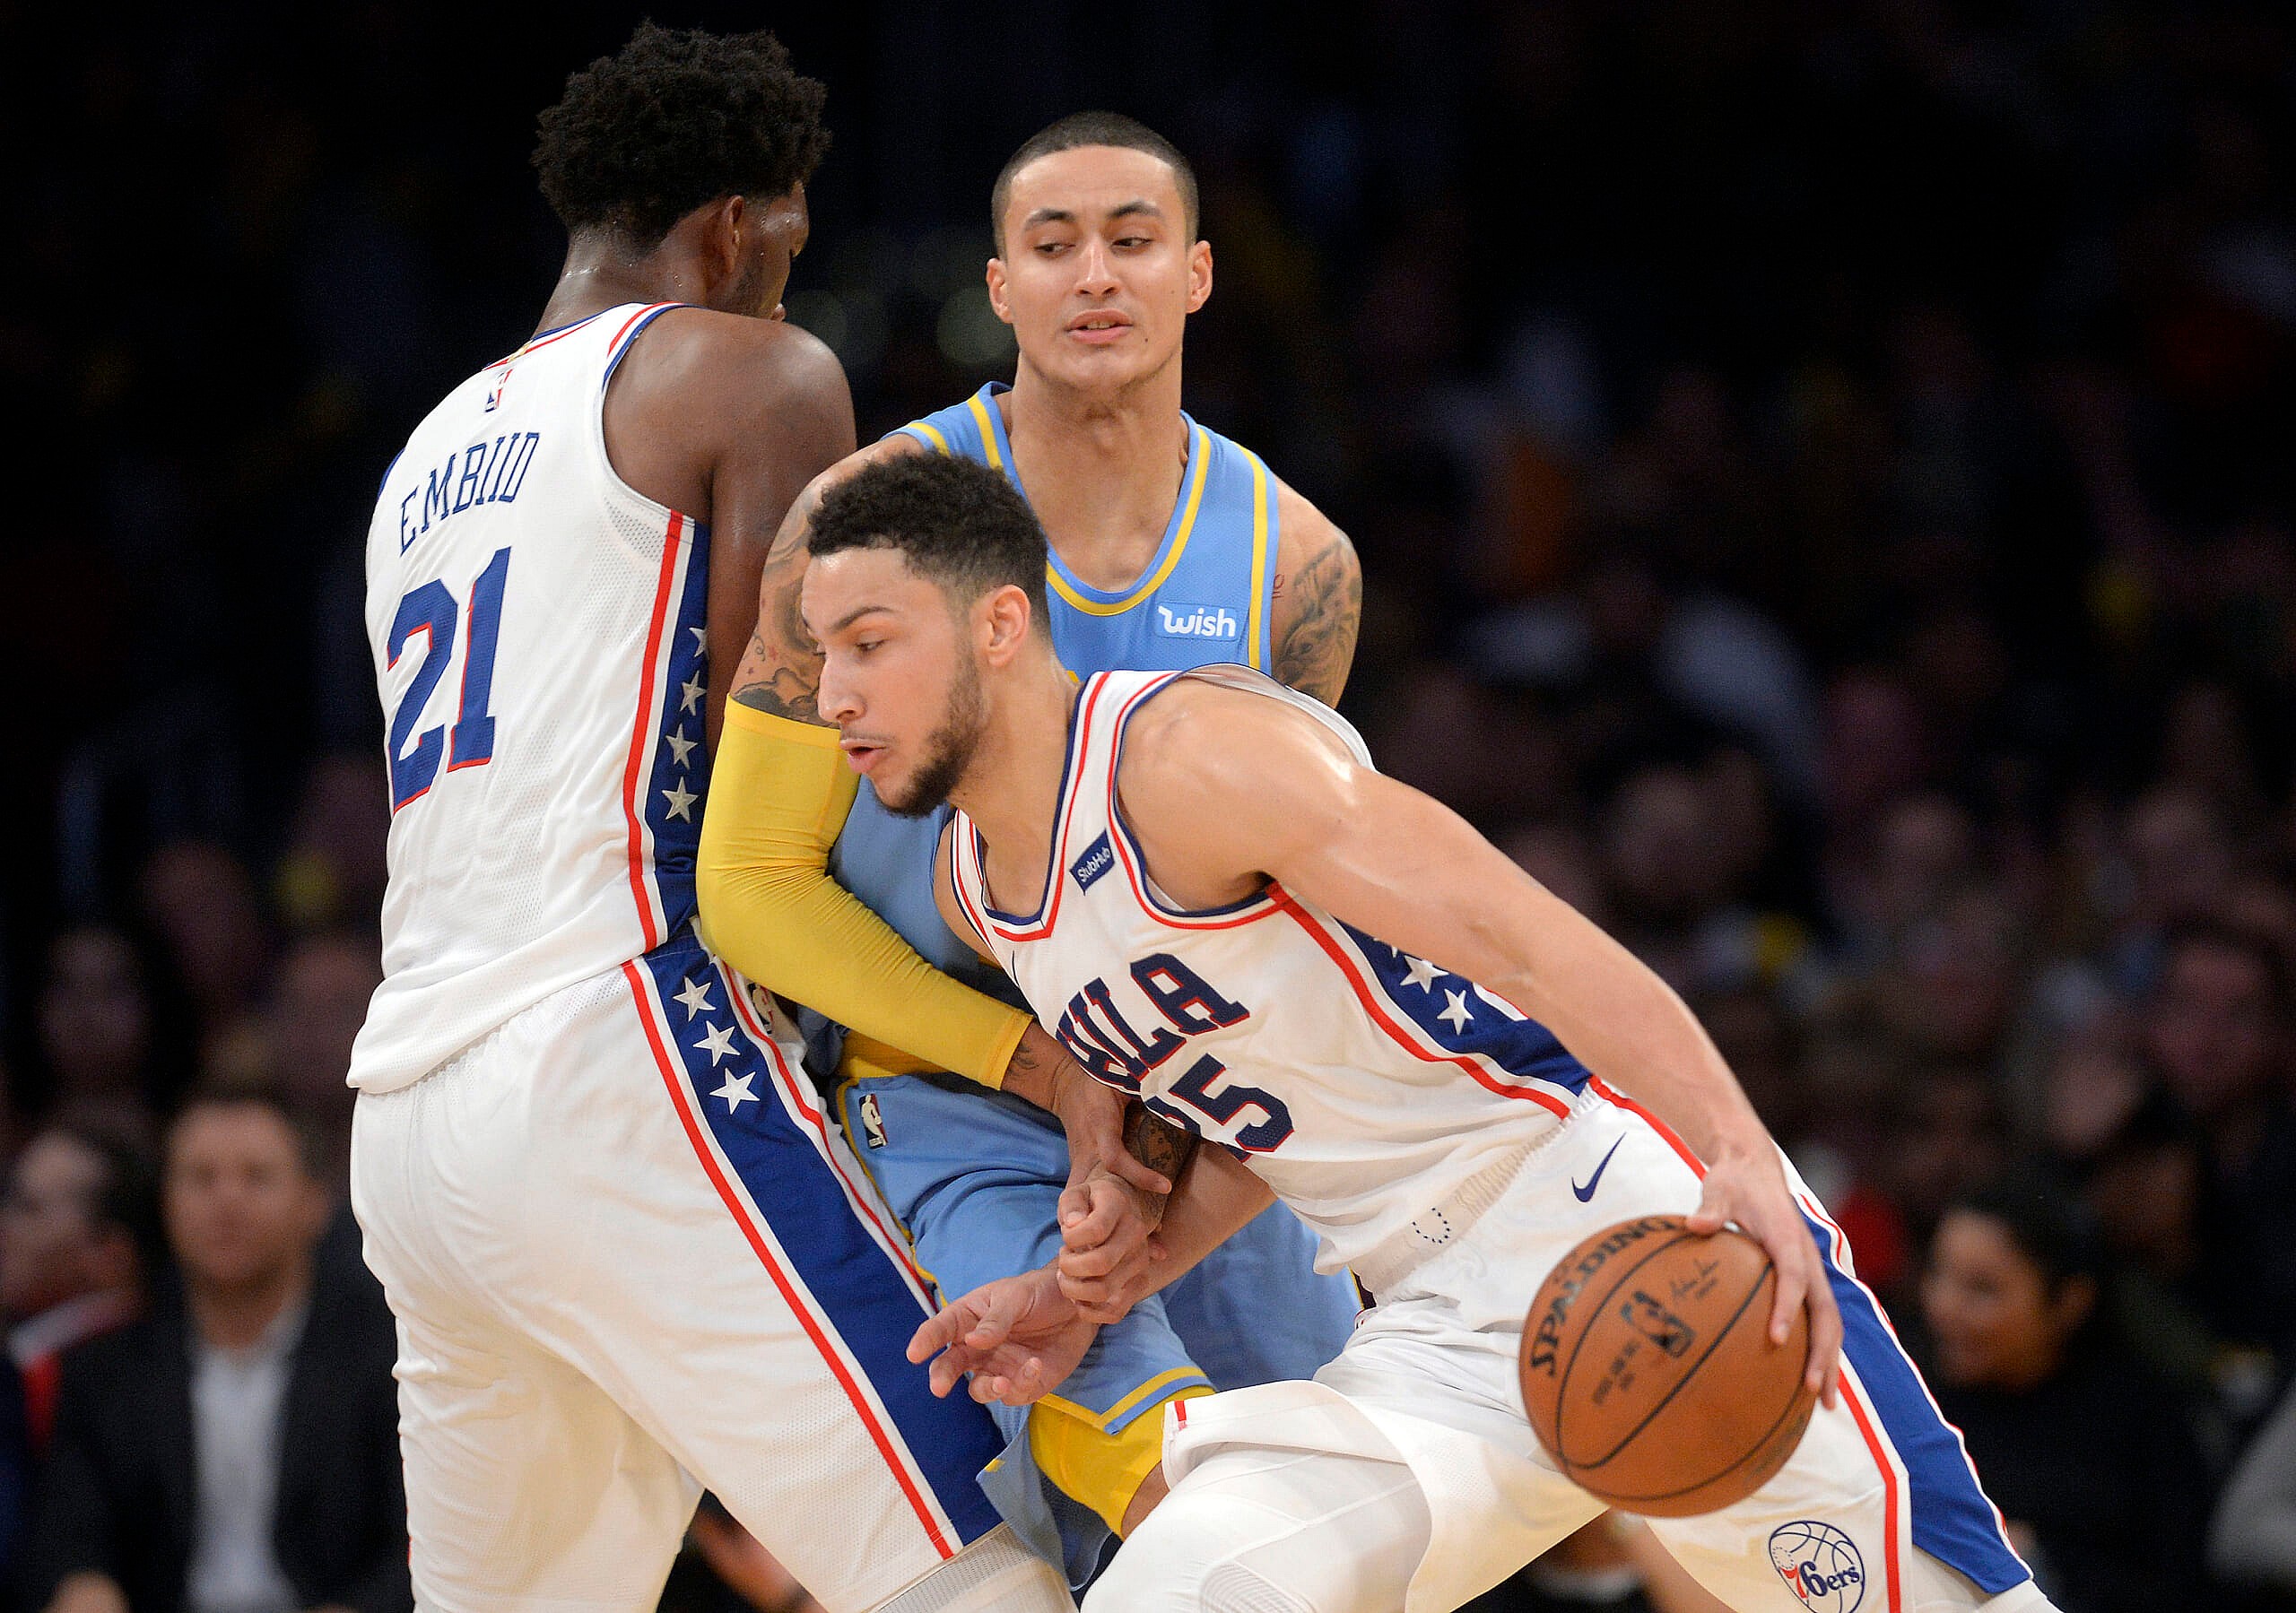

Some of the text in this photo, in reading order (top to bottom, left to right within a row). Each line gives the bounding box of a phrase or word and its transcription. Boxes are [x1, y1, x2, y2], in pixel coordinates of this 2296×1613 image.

[399, 431, 540, 558] EMBIID
[387, 545, 511, 817] 21
[1055, 952, 1250, 1095] HILA
[1779, 1560, 1860, 1599] 76ers
